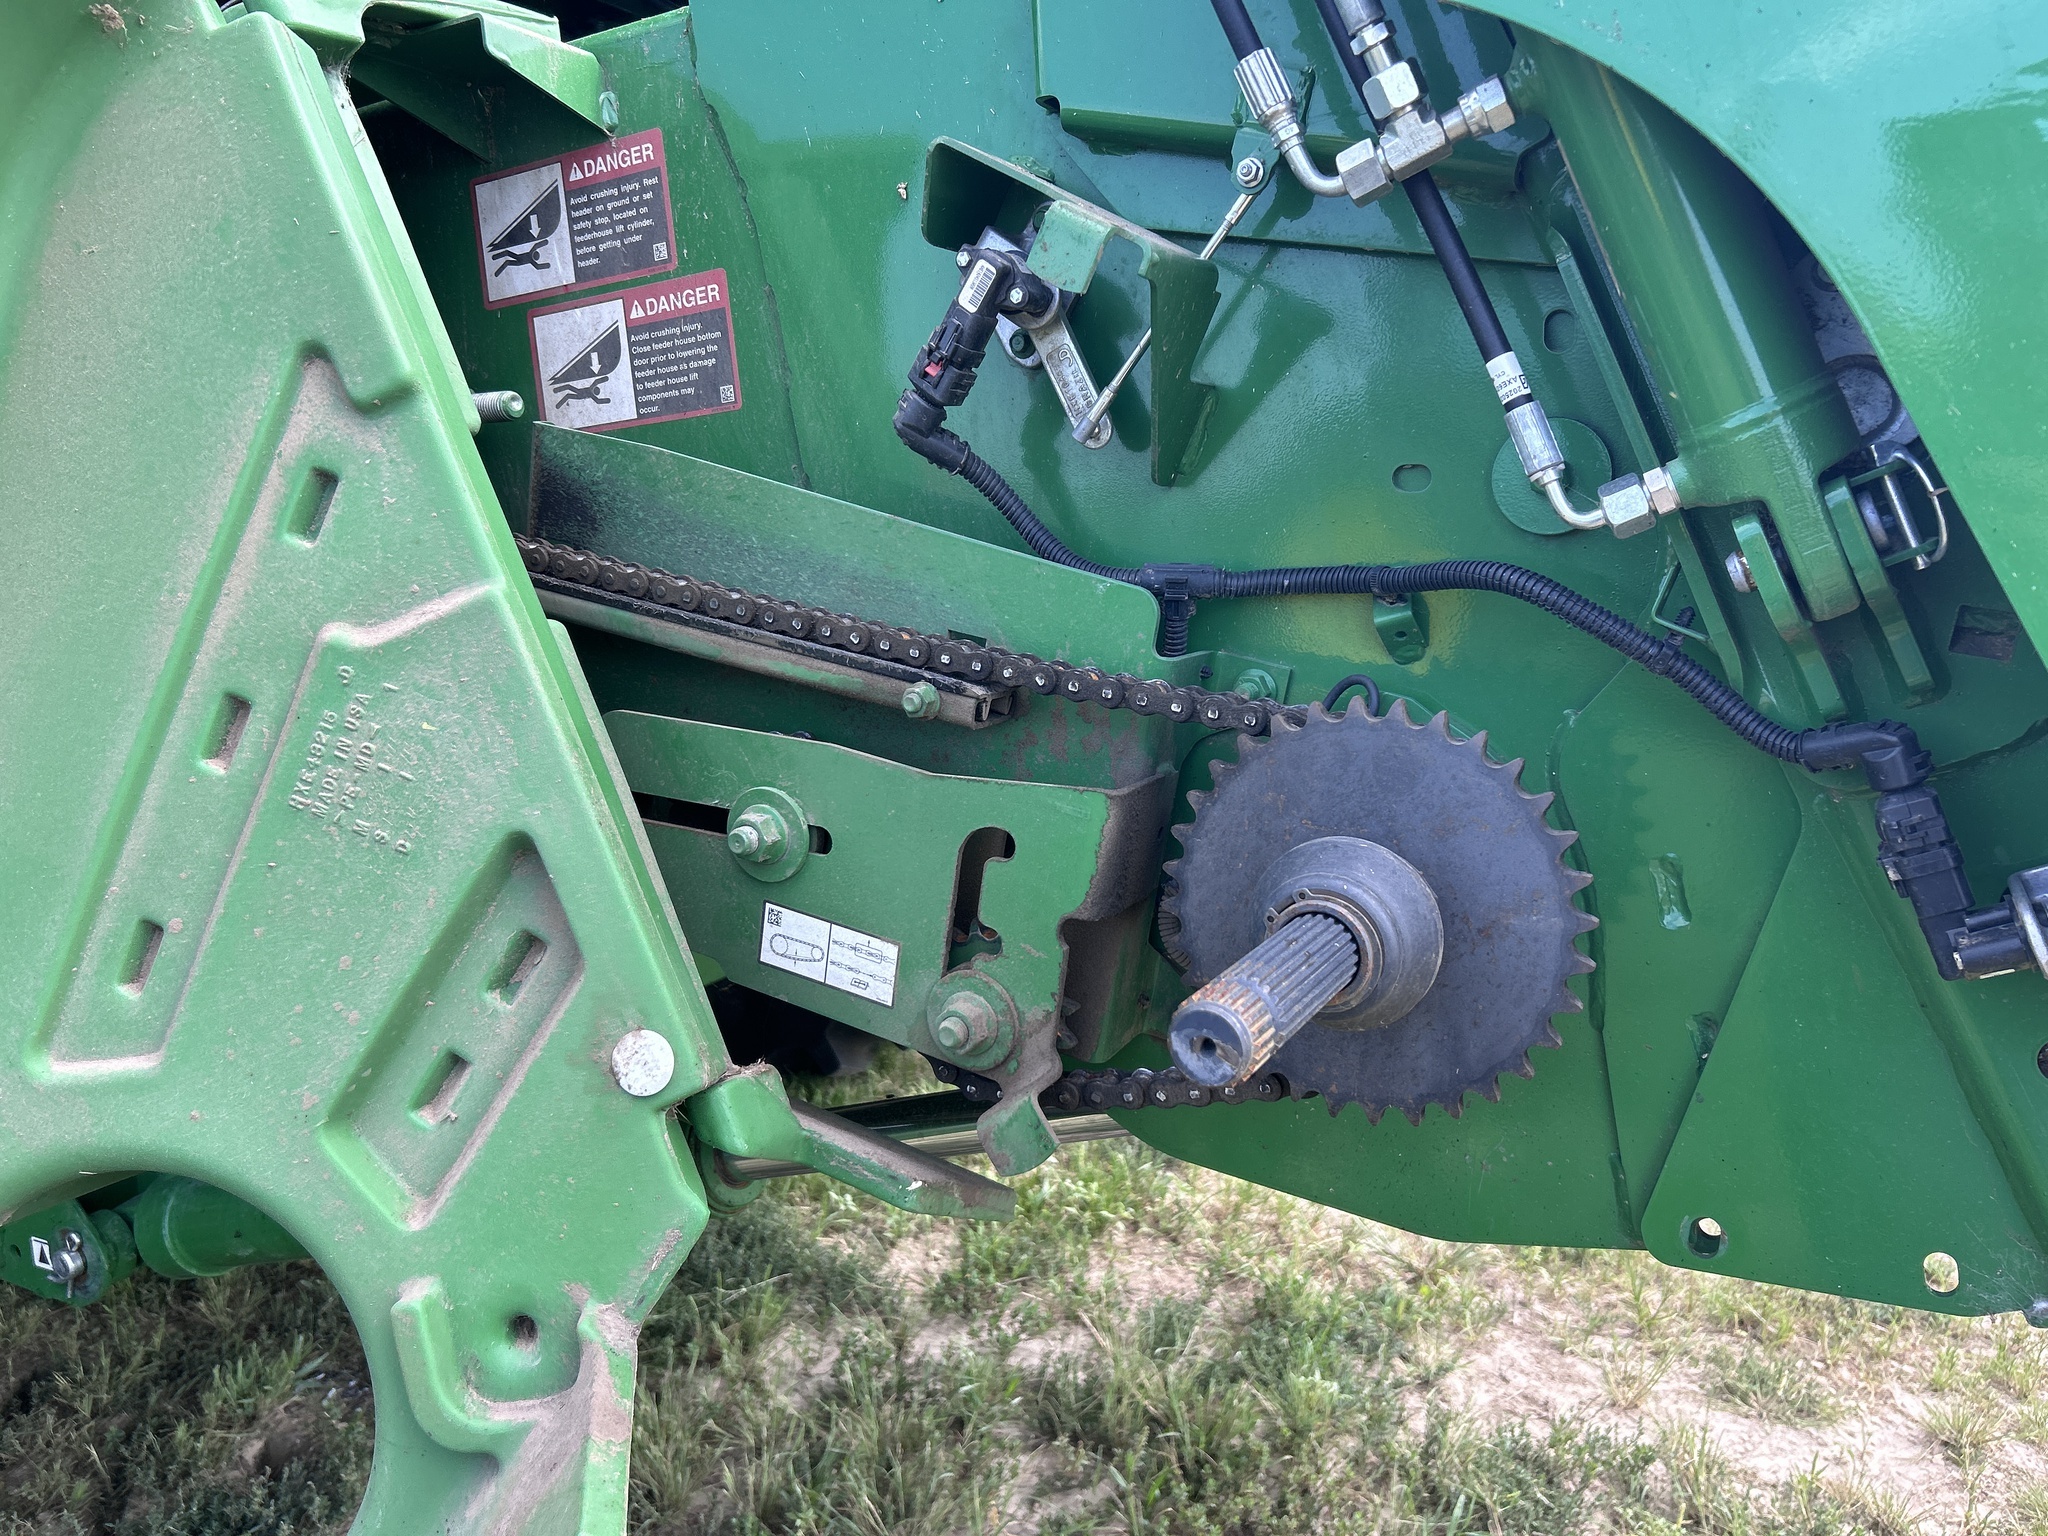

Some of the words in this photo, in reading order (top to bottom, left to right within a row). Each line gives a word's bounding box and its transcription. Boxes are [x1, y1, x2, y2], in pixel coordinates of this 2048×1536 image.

[584, 143, 654, 176] DANGER
[570, 192, 587, 205] Avoid
[590, 187, 618, 200] crushing
[621, 182, 640, 195] injury.
[643, 177, 658, 188] Rest
[571, 206, 592, 218] header
[596, 204, 604, 212] on
[607, 197, 629, 210] ground
[633, 195, 639, 203] or
[643, 191, 653, 201] set
[573, 218, 591, 231] safety
[594, 215, 611, 226] stop,
[613, 208, 636, 221] located
[640, 206, 648, 214] on
[574, 229, 613, 243] feederhouse
[616, 224, 624, 233] lift
[627, 218, 655, 231] cylinder,
[576, 244, 596, 256] before
[599, 238, 620, 251] getting
[624, 234, 642, 244] under
[577, 257, 601, 267] header.
[646, 284, 720, 316] DANGER
[630, 330, 649, 342] Avoid
[651, 325, 680, 339] crushing
[682, 322, 703, 334] injury.
[632, 343, 651, 354] Close
[652, 340, 673, 351] feeder
[675, 336, 696, 348] house
[697, 330, 722, 342] bottom
[633, 355, 649, 366] door
[651, 352, 667, 365] prior
[668, 351, 675, 360] to
[677, 346, 705, 361] lowering
[707, 344, 718, 353] the
[635, 366, 656, 378] feeder
[657, 363, 678, 375] house
[680, 362, 687, 370] as
[689, 357, 716, 371] damage
[636, 382, 644, 391] to
[645, 378, 666, 389] feeder
[667, 374, 688, 385] house
[689, 372, 699, 381] lift
[638, 389, 679, 403] components
[681, 387, 695, 396] may
[639, 405, 660, 415] occur.
[310, 764, 343, 819] MADE
[334, 736, 354, 761] IN
[344, 693, 373, 731] USA
